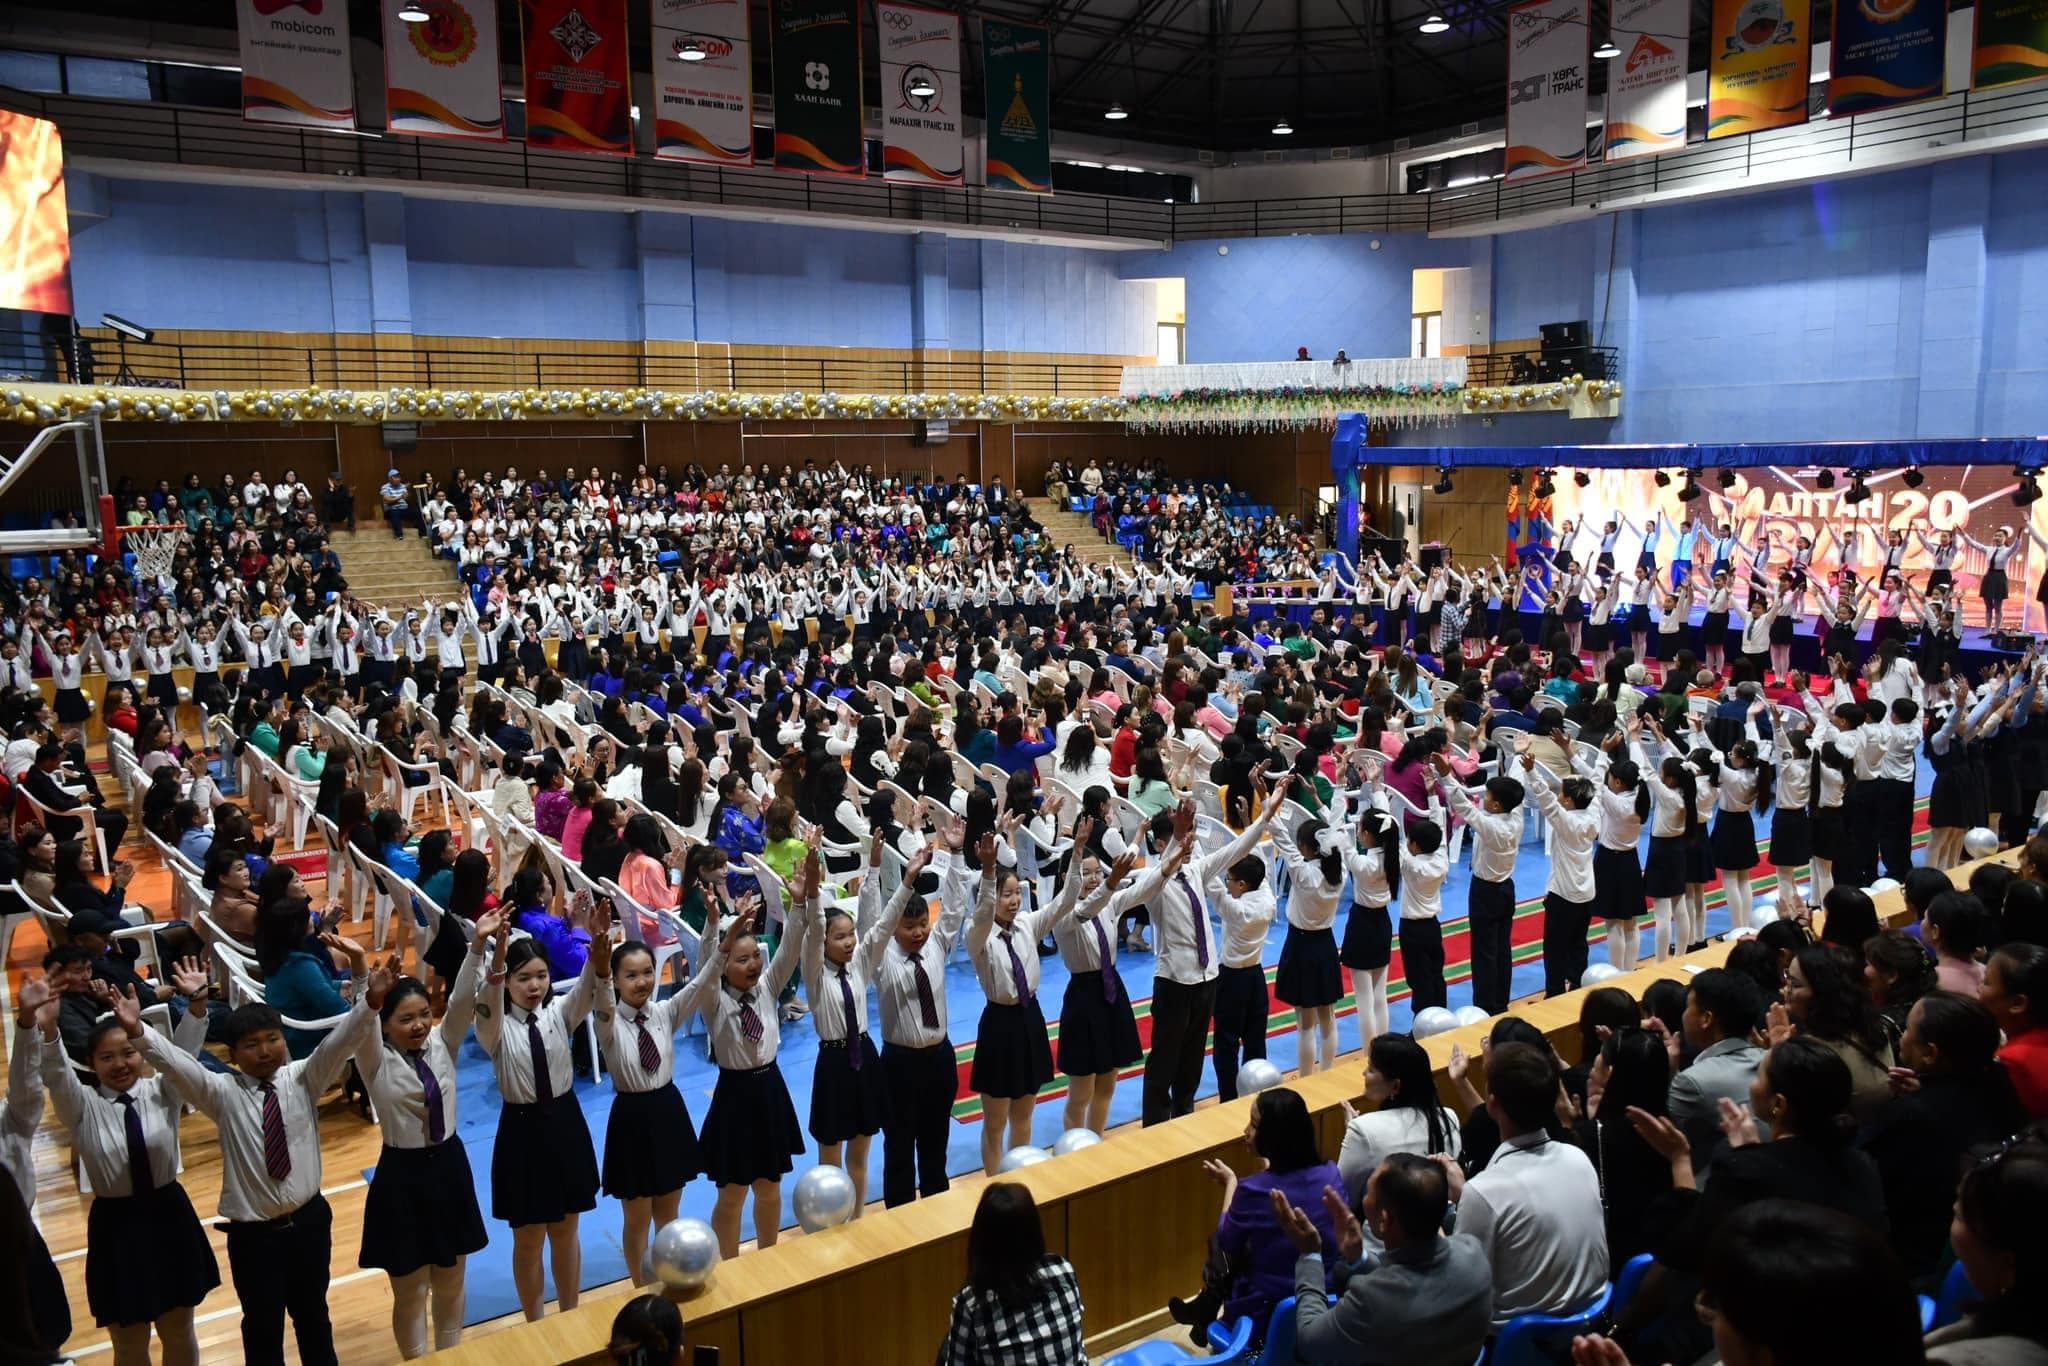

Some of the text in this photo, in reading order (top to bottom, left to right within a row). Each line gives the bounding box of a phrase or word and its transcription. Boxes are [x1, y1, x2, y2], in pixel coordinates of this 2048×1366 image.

[271, 20, 335, 36] mobicom
[1552, 65, 1579, 82] ХӨРС
[1552, 78, 1584, 95] ТРАНС
[793, 93, 842, 107] ХААН БАНК
[923, 119, 942, 130] ТРАНС
[1768, 490, 1970, 531] АЛТАН 20
